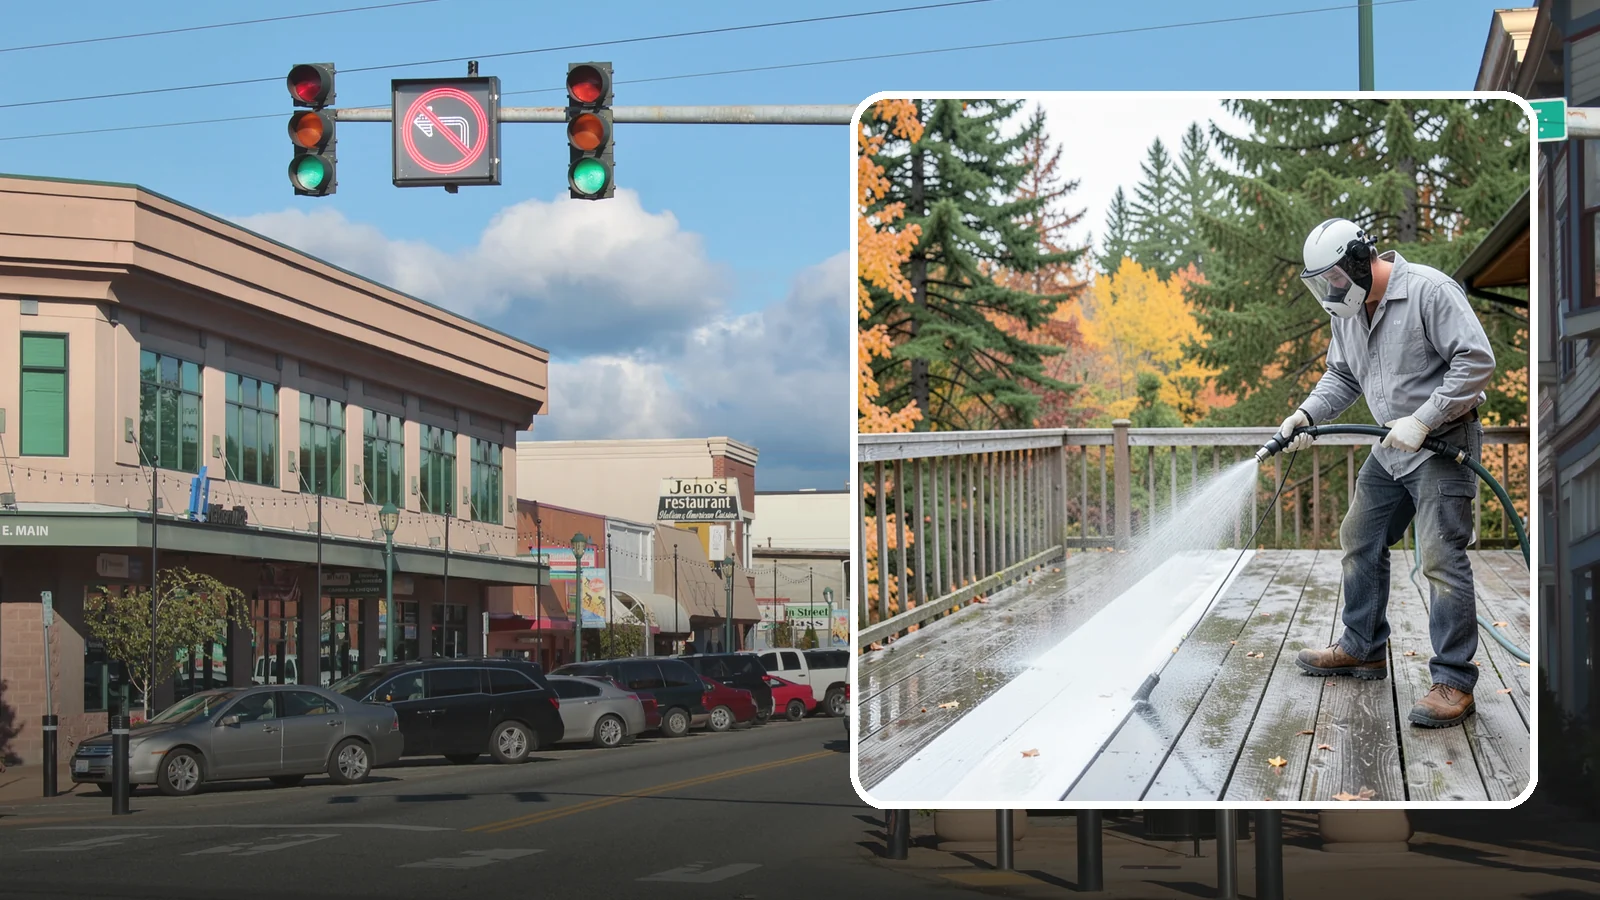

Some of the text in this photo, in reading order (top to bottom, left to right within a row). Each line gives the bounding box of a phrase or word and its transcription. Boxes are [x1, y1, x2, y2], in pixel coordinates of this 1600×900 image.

[670, 480, 727, 494] Jeno's
[665, 496, 730, 508] restaurant
[658, 510, 681, 519] Italian
[686, 509, 714, 519] American
[714, 509, 738, 519] Cuisine
[2, 525, 49, 536] E. MAIN
[785, 608, 828, 617] in Street
